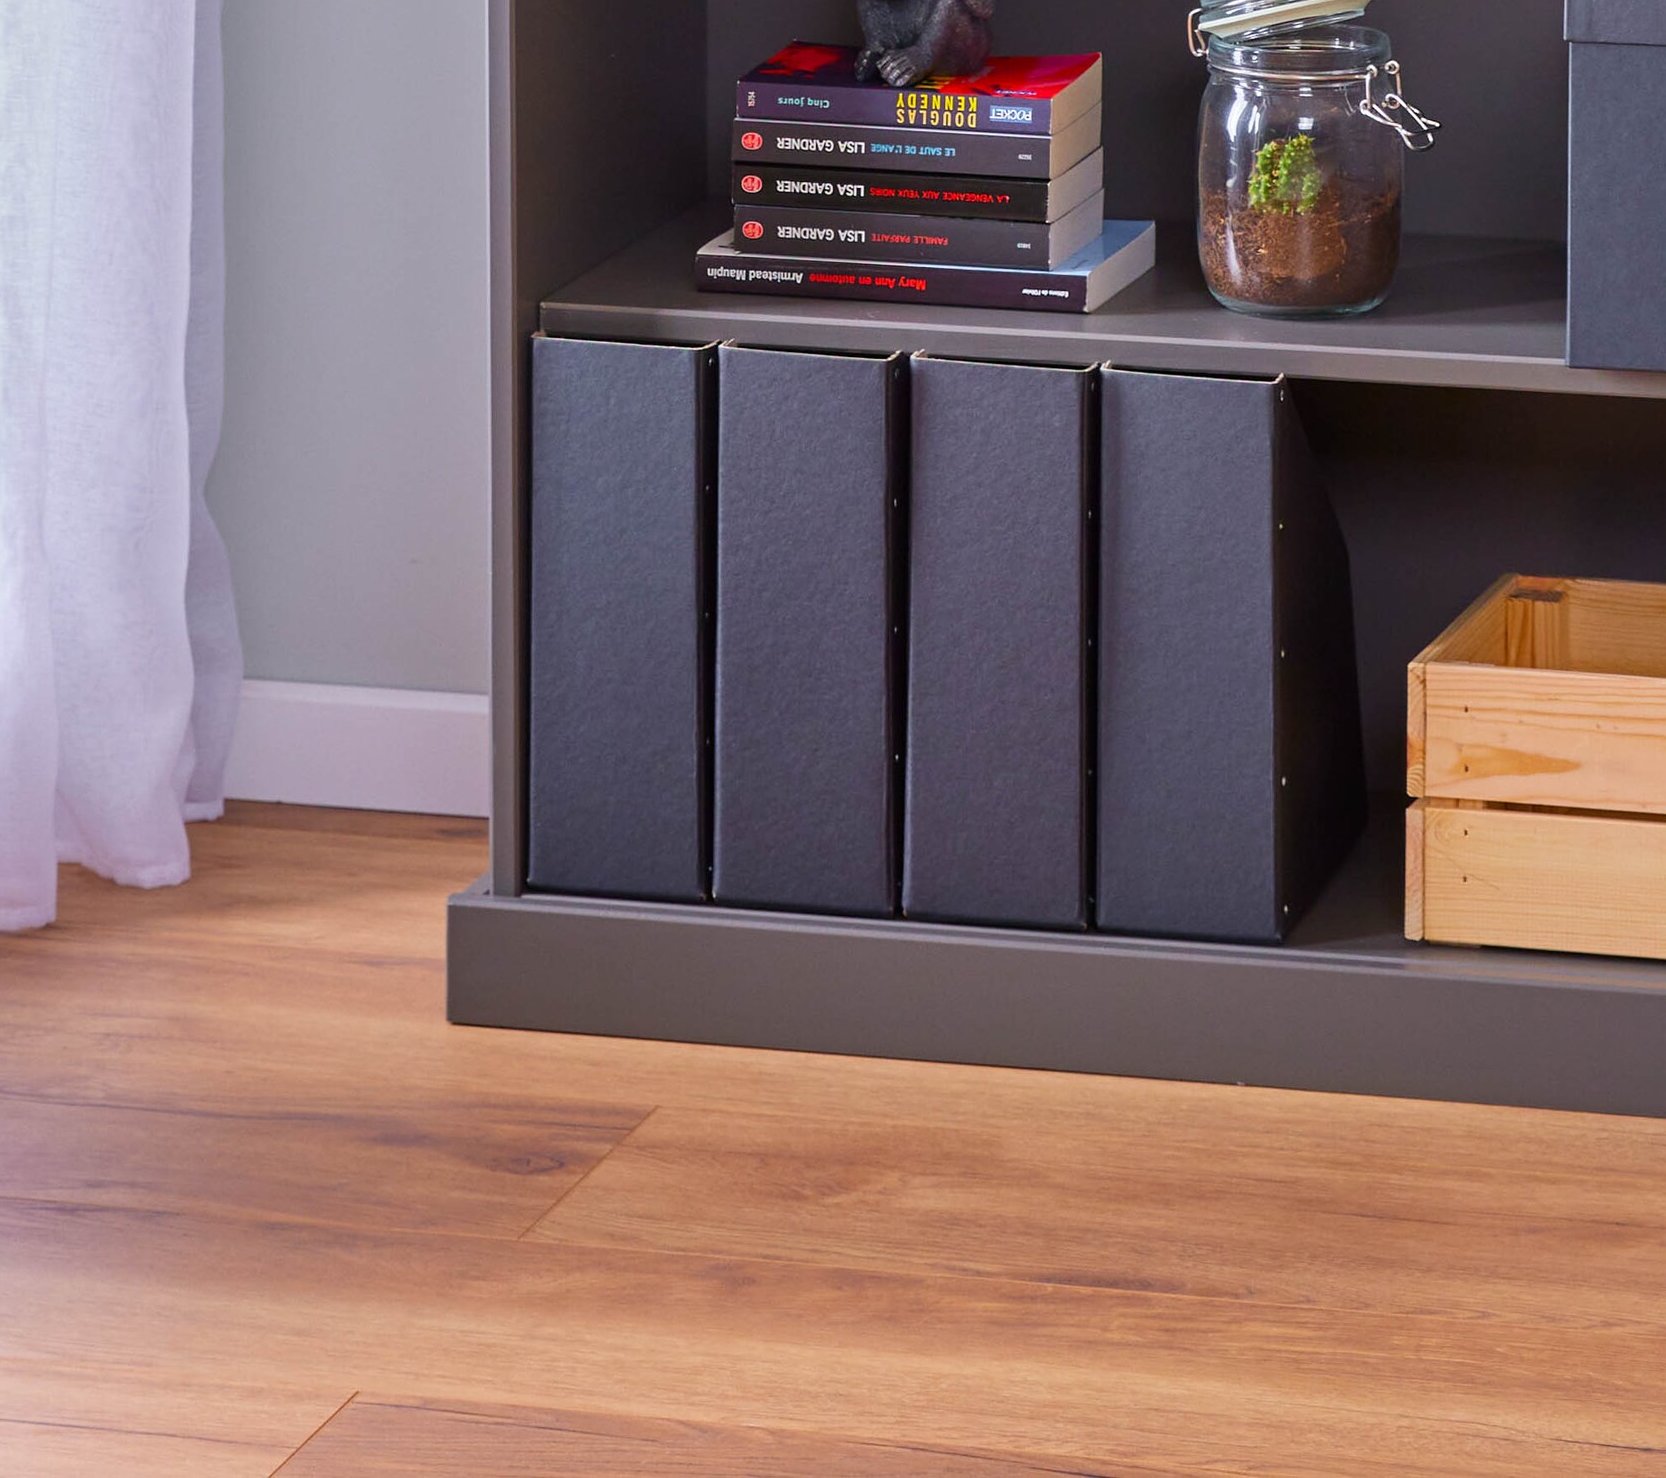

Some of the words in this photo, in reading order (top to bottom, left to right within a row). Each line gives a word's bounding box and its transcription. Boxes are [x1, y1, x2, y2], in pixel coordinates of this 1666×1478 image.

[778, 97, 805, 107] jours
[807, 99, 830, 109] Cinq
[896, 93, 978, 111] KENNEDY
[896, 109, 977, 128] DOUGLAS
[990, 107, 1032, 121] POCKET
[776, 137, 834, 151] GARDNER
[839, 140, 866, 154] LISA
[871, 143, 903, 153] L'ANGE
[905, 145, 917, 154] DE
[919, 146, 942, 155] SAUT
[945, 147, 955, 156] LE
[776, 180, 834, 195] GARDNER
[837, 183, 865, 197] LISA
[777, 226, 834, 240] GARDNER
[838, 229, 866, 243] LISA
[707, 267, 746, 281] Maupin
[748, 269, 803, 283] Armistead
[809, 273, 856, 285] automne
[859, 277, 872, 285] en
[874, 278, 895, 289] Ann
[899, 277, 926, 291] Mary
